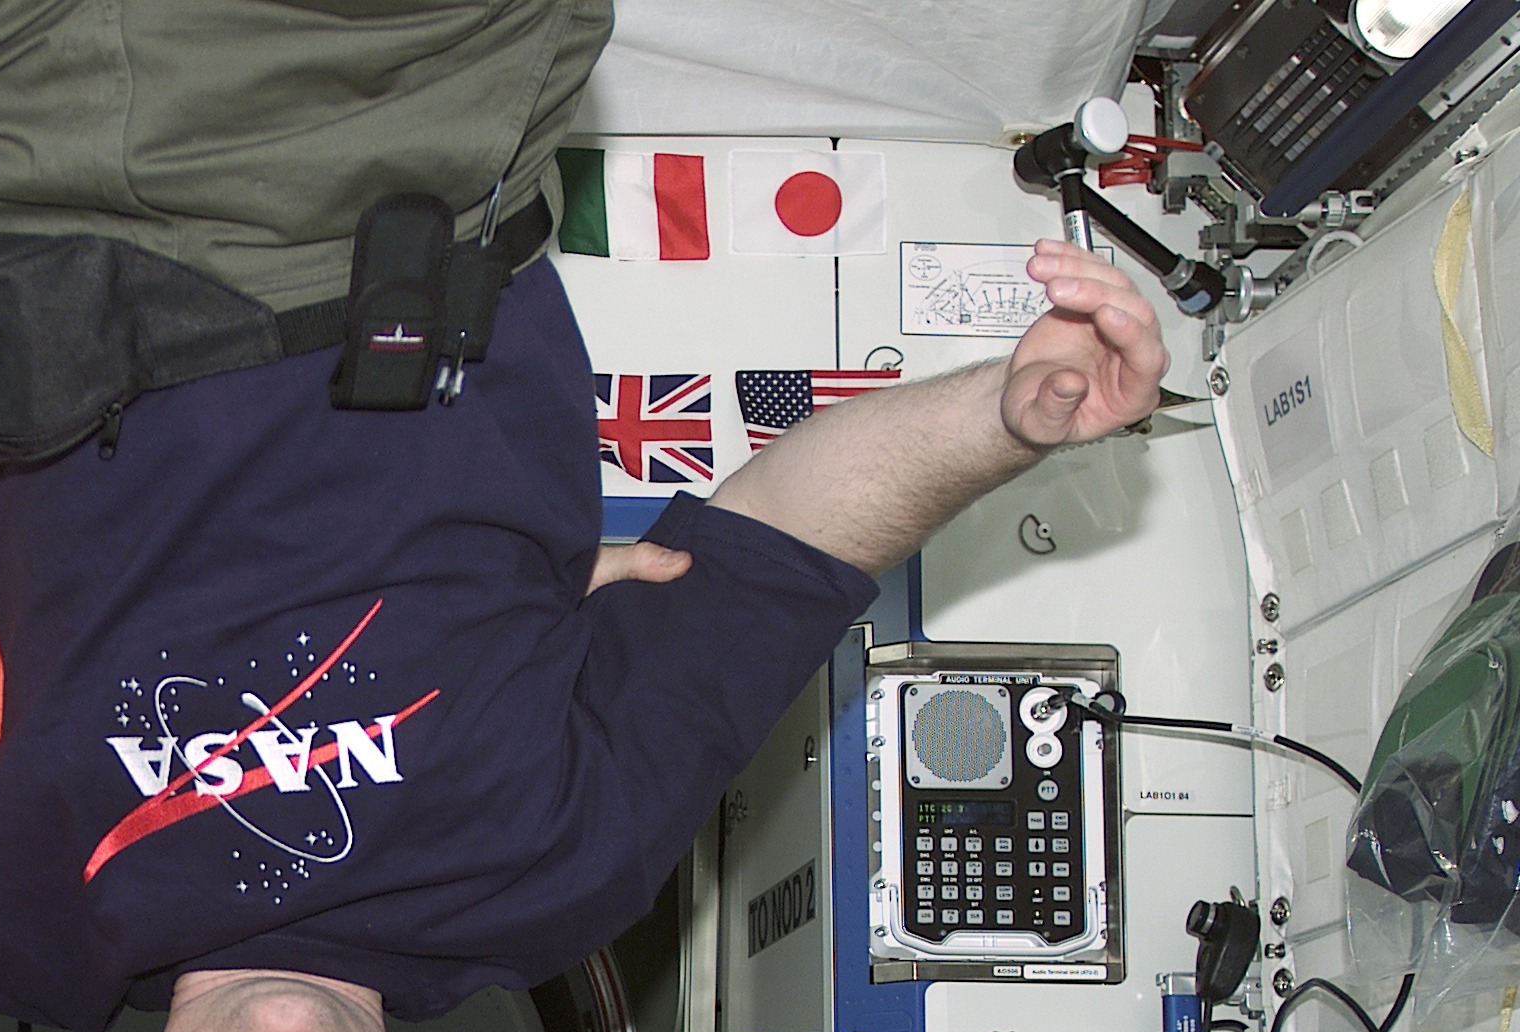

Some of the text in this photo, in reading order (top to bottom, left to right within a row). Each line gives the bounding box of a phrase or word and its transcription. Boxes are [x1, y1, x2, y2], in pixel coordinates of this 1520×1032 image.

[1264, 374, 1312, 427] LAB1S1
[946, 675, 970, 684] AUDIO
[974, 675, 1013, 684] TERMINAL
[105, 714, 404, 798] NASA
[1041, 786, 1056, 794] PTT
[749, 866, 816, 954] TO NOD 2
